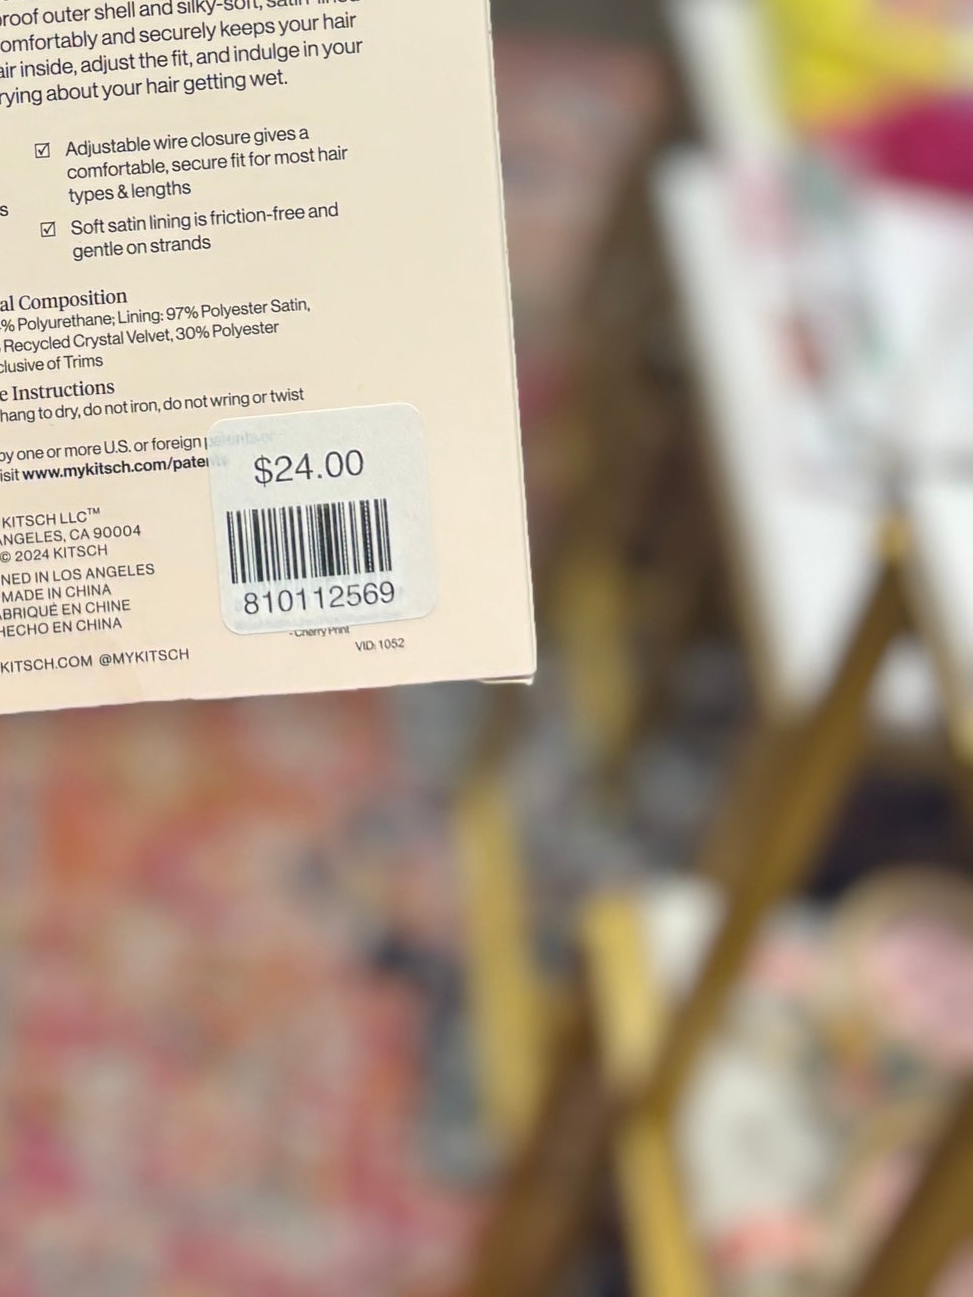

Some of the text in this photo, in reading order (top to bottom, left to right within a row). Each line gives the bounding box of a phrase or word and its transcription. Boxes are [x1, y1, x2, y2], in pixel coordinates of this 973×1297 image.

[41, 5, 92, 25] outer
[93, 0, 136, 21] shell
[100, 25, 137, 47] and
[138, 20, 217, 44] securely
[219, 19, 277, 39] keeps
[277, 17, 321, 37] your
[322, 10, 358, 31] hair
[64, 126, 311, 159] Adjustable wire closure gives a
[66, 144, 349, 181] comfortable, secure fit for most hair
[70, 200, 340, 237] Soft satin lining is friction-free and
[71, 233, 212, 263] gentle on strands
[17, 288, 129, 313] Composition
[16, 313, 116, 334] Polyurethane;
[116, 308, 165, 325] Lining:
[165, 305, 200, 322] 97%
[200, 301, 269, 320] Polyester
[270, 297, 311, 314] Satin,
[2, 334, 72, 355] Recycled
[72, 330, 125, 351] Crystal
[125, 328, 174, 345] Velvet,
[174, 324, 211, 342] 30%
[211, 320, 280, 340] Polyester
[45, 355, 62, 371] of
[62, 353, 105, 370] Trims
[11, 380, 116, 402] Instructions
[0, 408, 36, 424] hang
[37, 406, 54, 421] to
[54, 403, 82, 421] dry,
[82, 401, 103, 418] do
[103, 400, 129, 416] not
[129, 399, 162, 414] iron,
[162, 396, 183, 411] do
[183, 394, 209, 410] not
[209, 391, 251, 409] wring
[251, 392, 269, 405] or
[268, 387, 305, 404] twist
[253, 448, 365, 489] $24.00
[1, 512, 57, 530] KITSCH
[68, 527, 91, 542] CA
[92, 523, 142, 540] 90004
[14, 548, 50, 563] 2024
[52, 543, 109, 560] KITSCH
[34, 570, 50, 584] IN
[52, 567, 83, 583] LOS
[85, 562, 156, 581] ANGELES
[0, 583, 113, 604] MADE IN CHINA
[243, 580, 396, 616] 810112569
[61, 602, 82, 617] EN
[84, 598, 132, 615] CHINE
[52, 619, 73, 634] EN
[75, 616, 123, 633] CHINA
[354, 637, 406, 652] VID: 1052
[98, 647, 190, 668] @MYKITSCH
